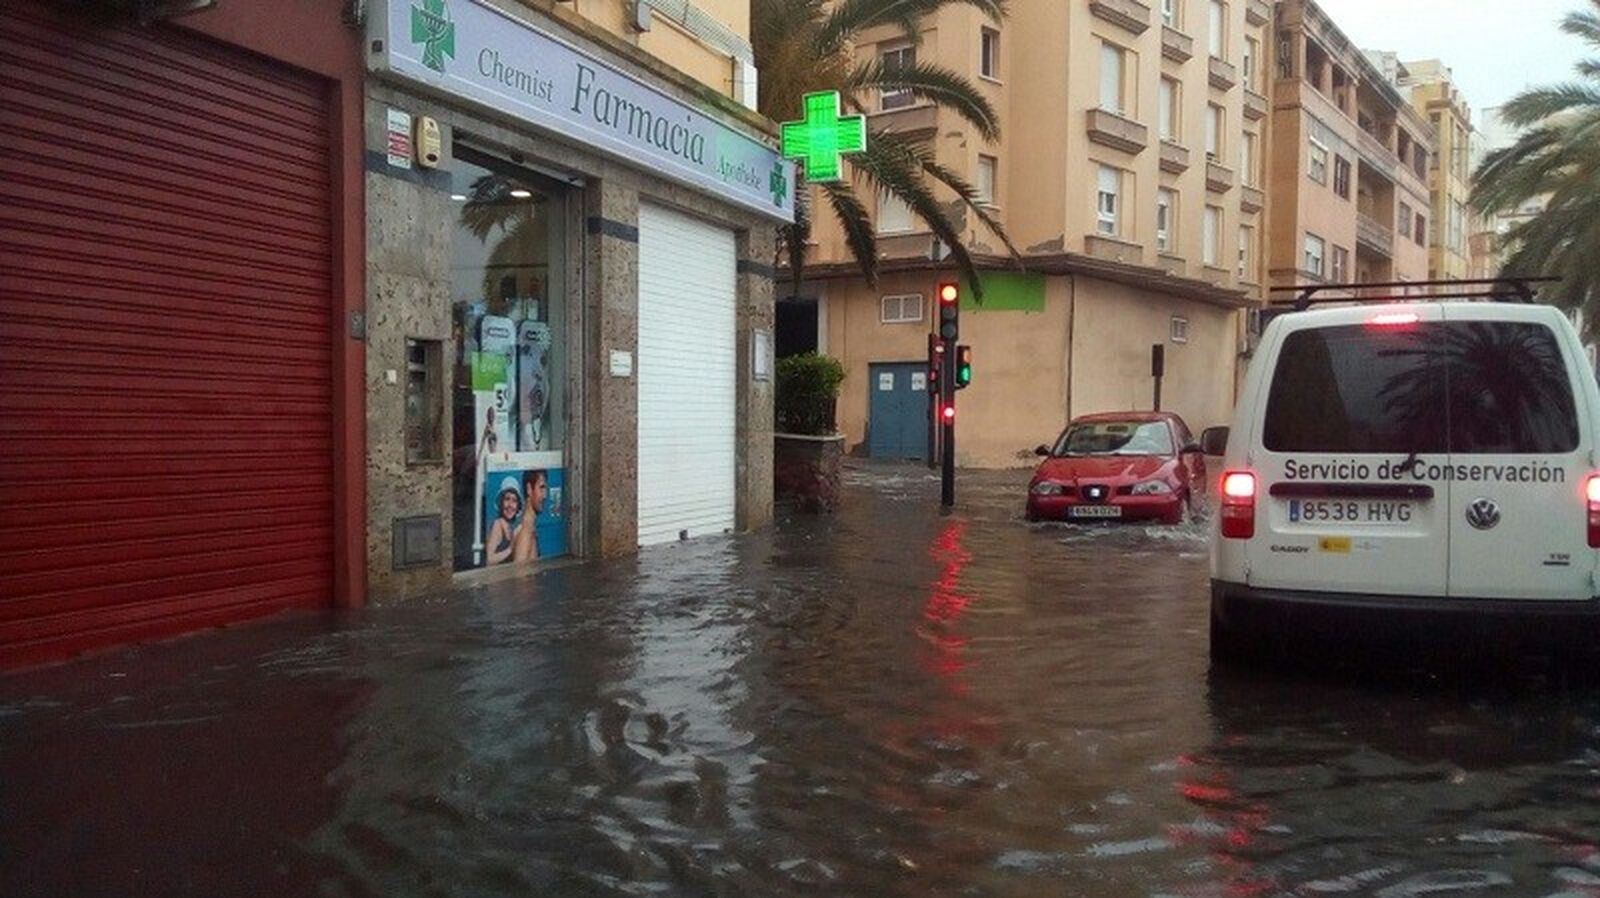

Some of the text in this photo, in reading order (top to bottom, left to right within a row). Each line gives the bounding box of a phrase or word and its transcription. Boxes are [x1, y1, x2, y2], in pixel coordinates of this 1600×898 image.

[478, 47, 554, 104] Chemist
[570, 63, 705, 165] Farmacia
[1284, 459, 1565, 483] Servicio de Conservación
[1303, 502, 1411, 521] 8538 HVG
